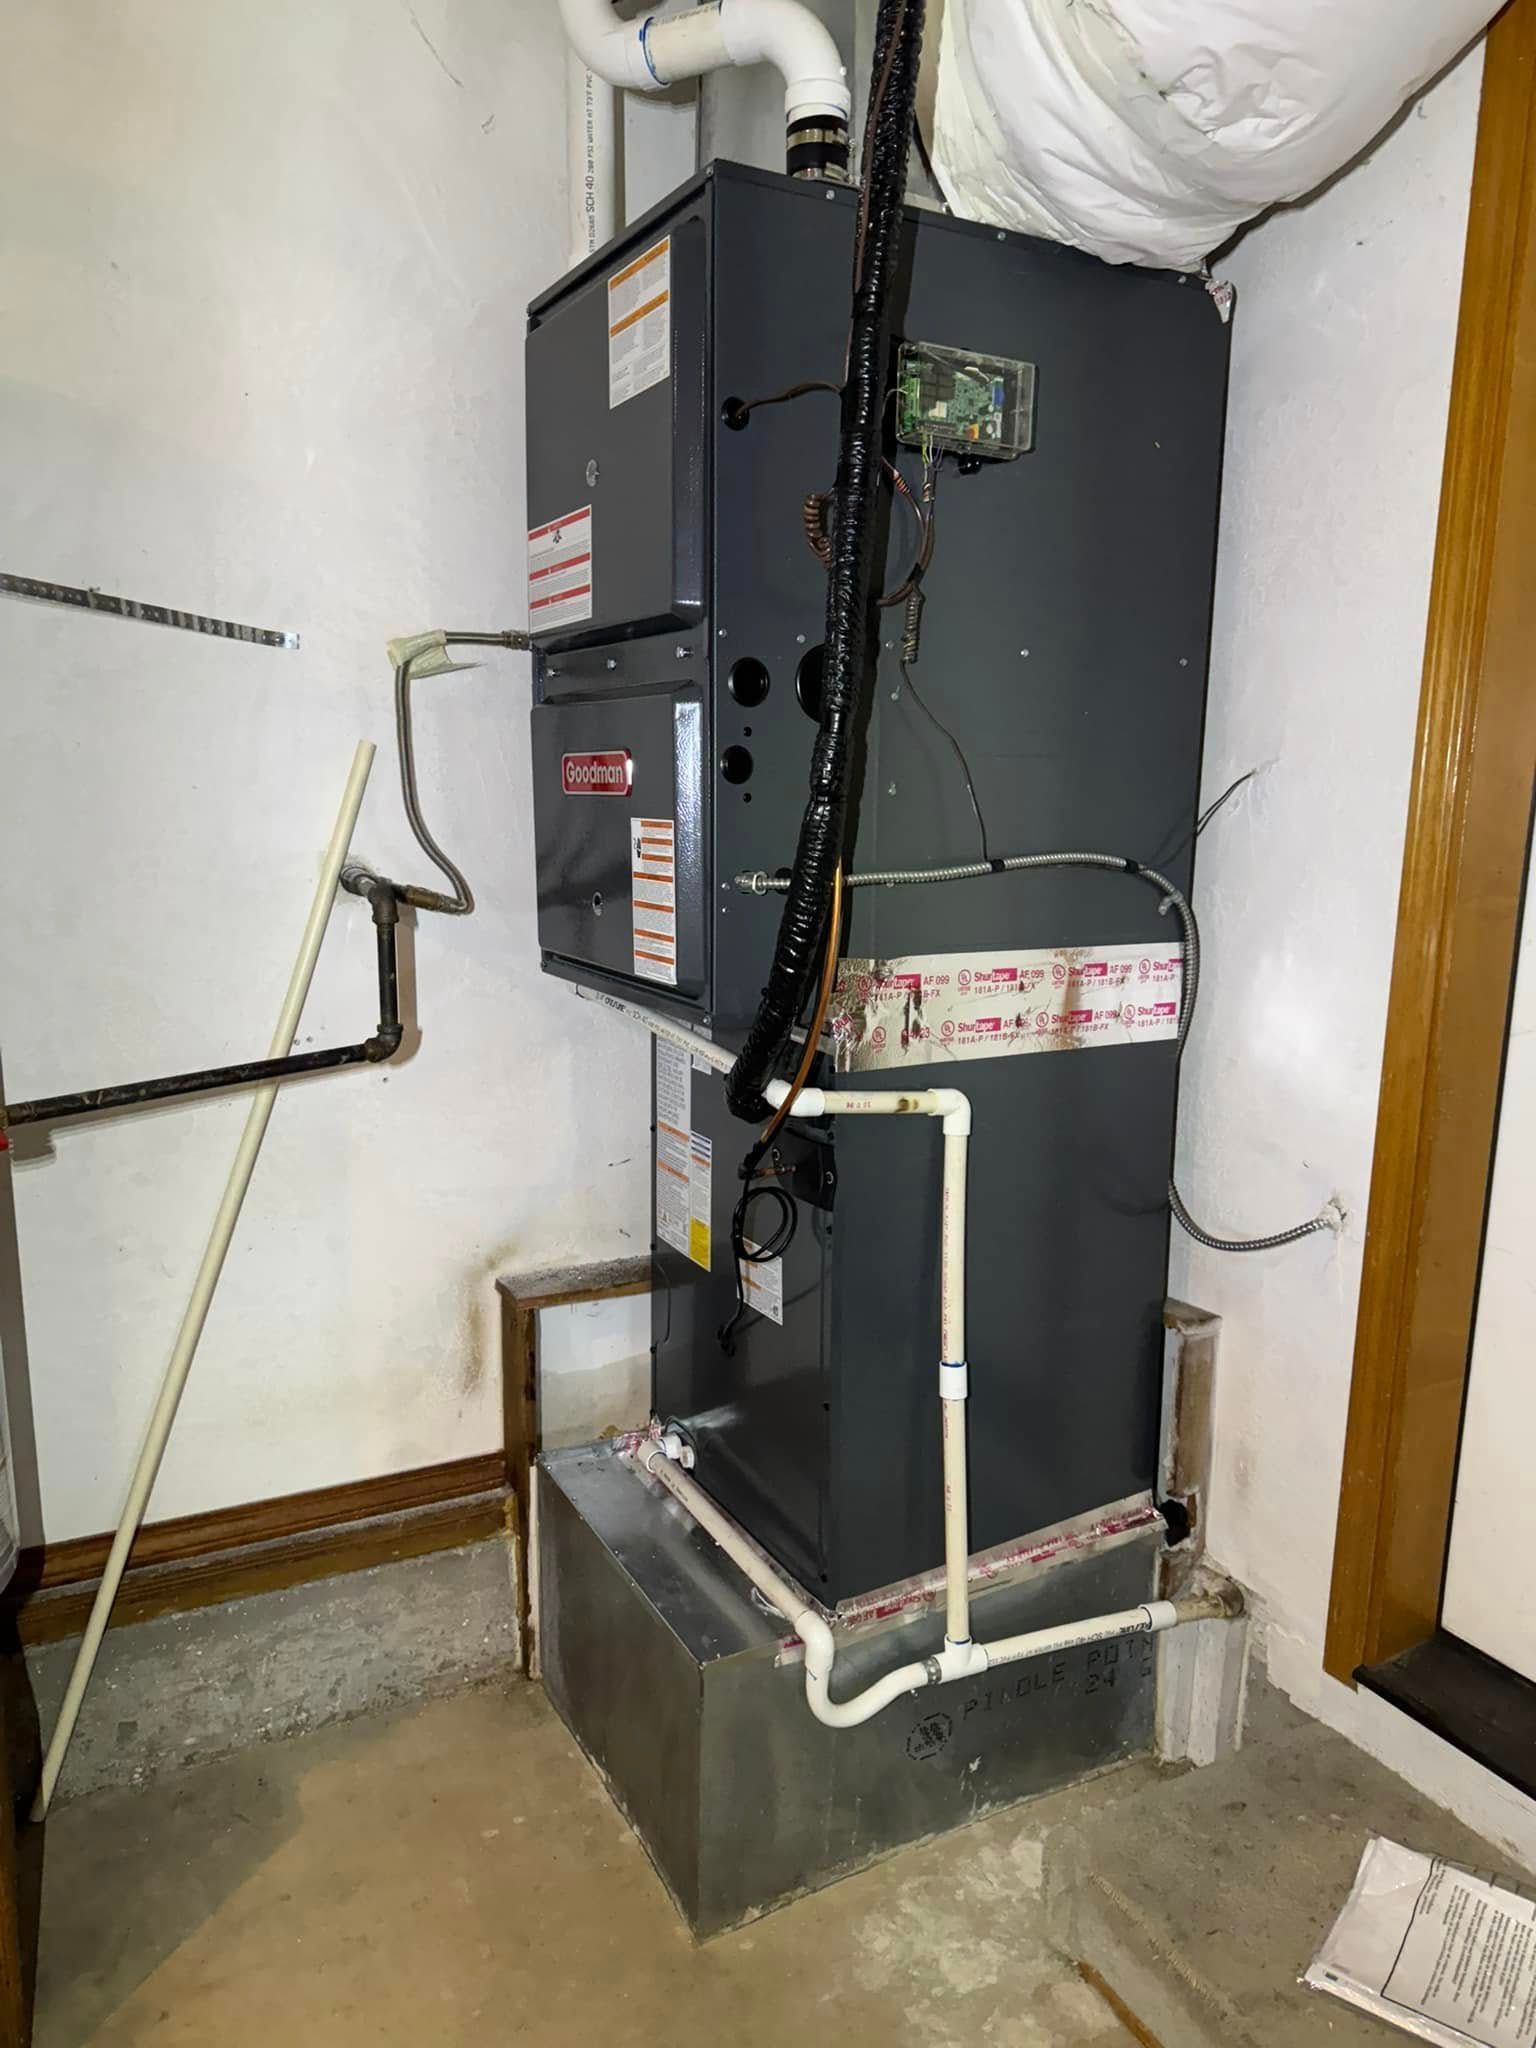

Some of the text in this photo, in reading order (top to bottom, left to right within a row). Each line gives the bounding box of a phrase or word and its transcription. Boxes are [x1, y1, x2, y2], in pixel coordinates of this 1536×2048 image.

[585, 176, 595, 190] 40
[585, 192, 595, 213] SCH
[566, 760, 624, 784] Goodman
[924, 976, 935, 985] AF
[936, 975, 950, 984] 099
[974, 970, 1012, 982] Shurtape
[1019, 970, 1030, 979] AF
[1031, 969, 1045, 978] 099
[1138, 1004, 1171, 1017] Shurtape
[958, 1020, 996, 1033] Shurtape
[1003, 1019, 1014, 1028] AF
